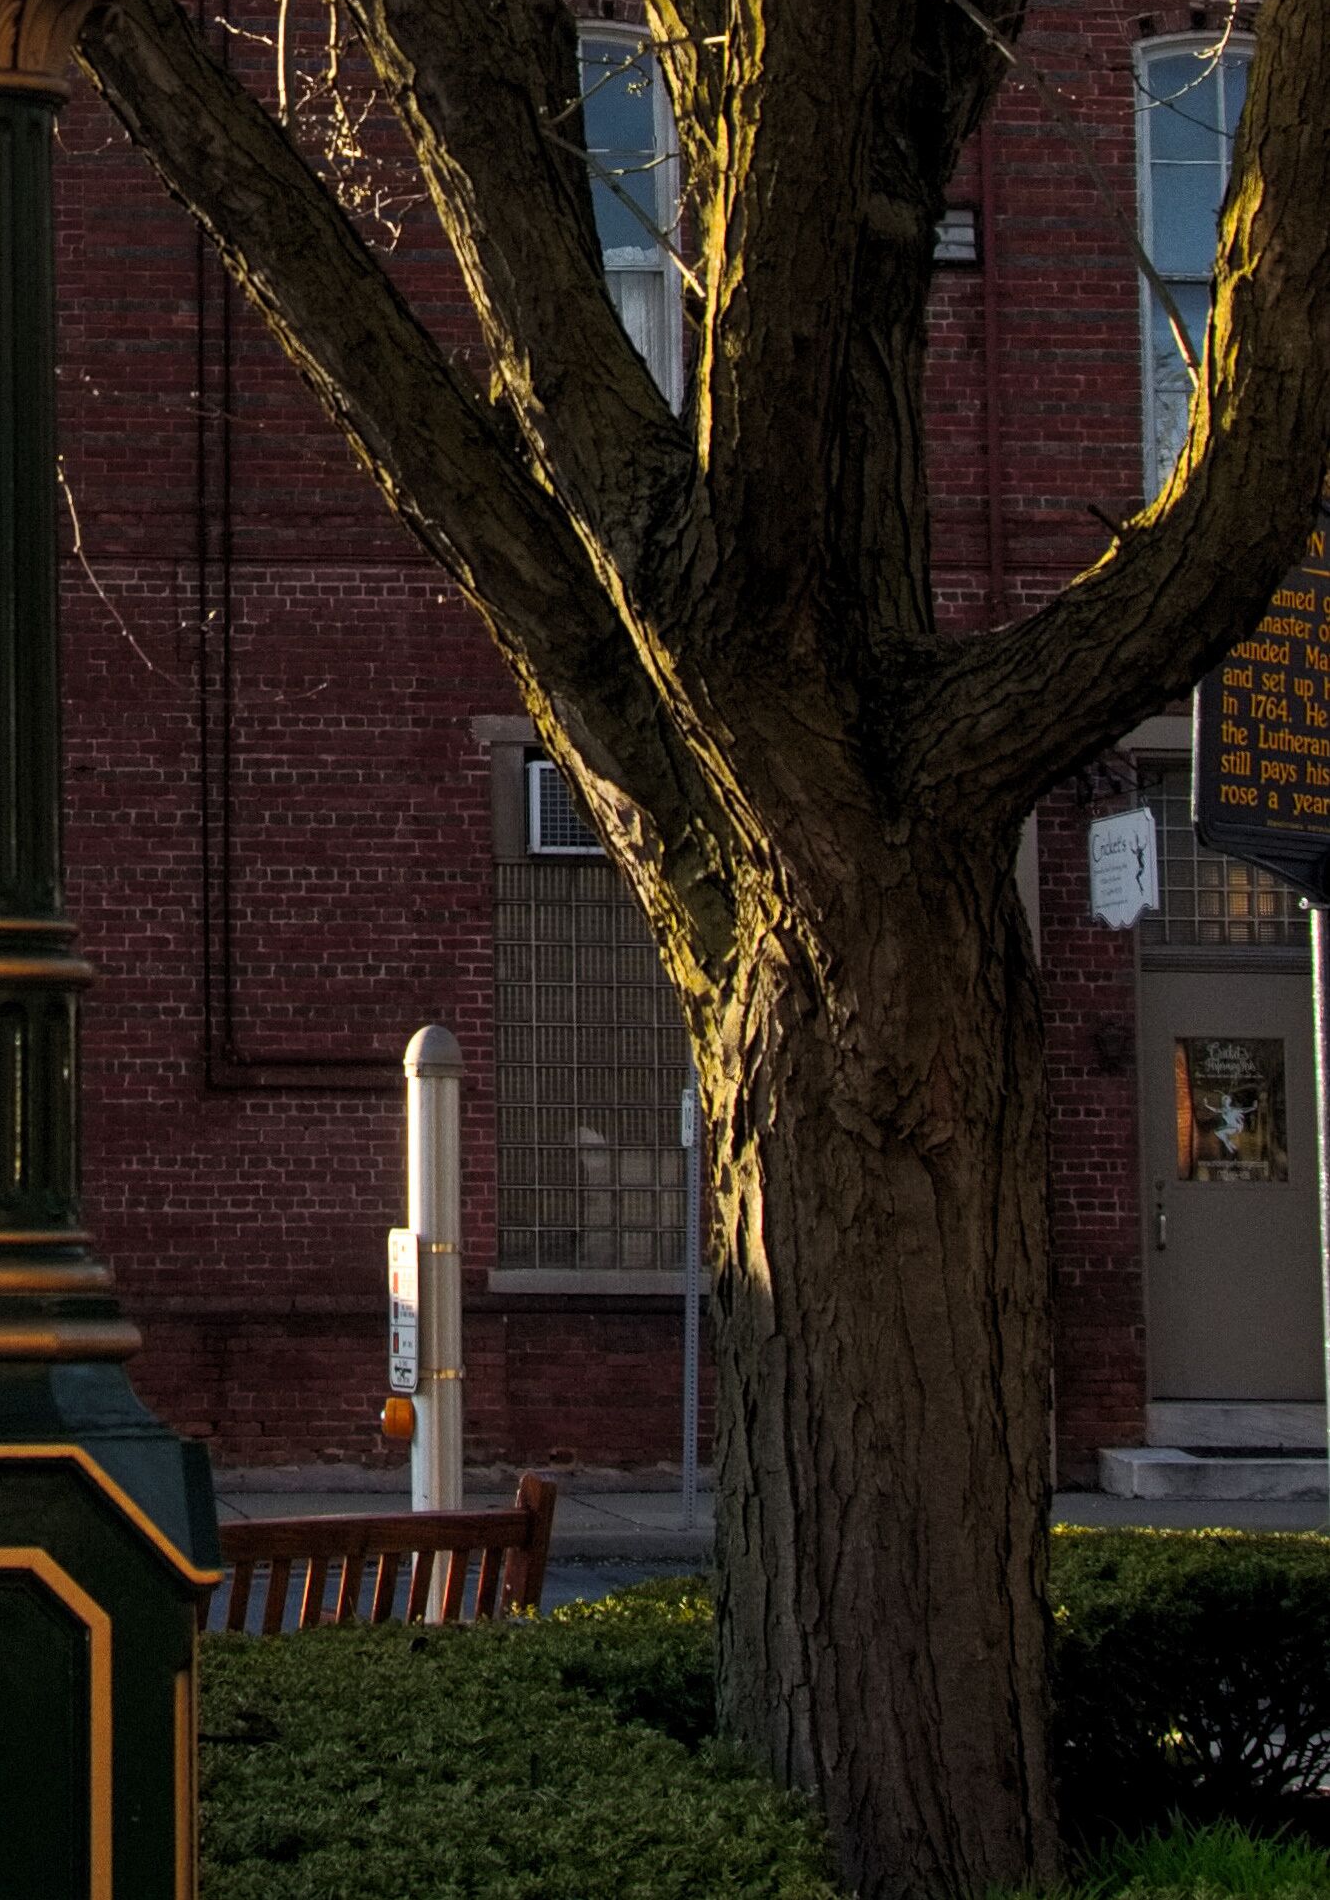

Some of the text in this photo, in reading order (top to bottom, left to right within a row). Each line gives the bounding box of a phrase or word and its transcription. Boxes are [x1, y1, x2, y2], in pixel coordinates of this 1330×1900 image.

[1271, 588, 1316, 612] amed
[1256, 615, 1312, 640] master
[1228, 641, 1290, 665] ounded
[1223, 665, 1254, 689] and
[1261, 670, 1286, 694] set
[1294, 677, 1314, 700] up
[1223, 690, 1328, 728] in 1764. He
[1221, 719, 1330, 757] the Lutheran
[1221, 750, 1330, 787] still pays his
[1220, 783, 1330, 817] rose a year
